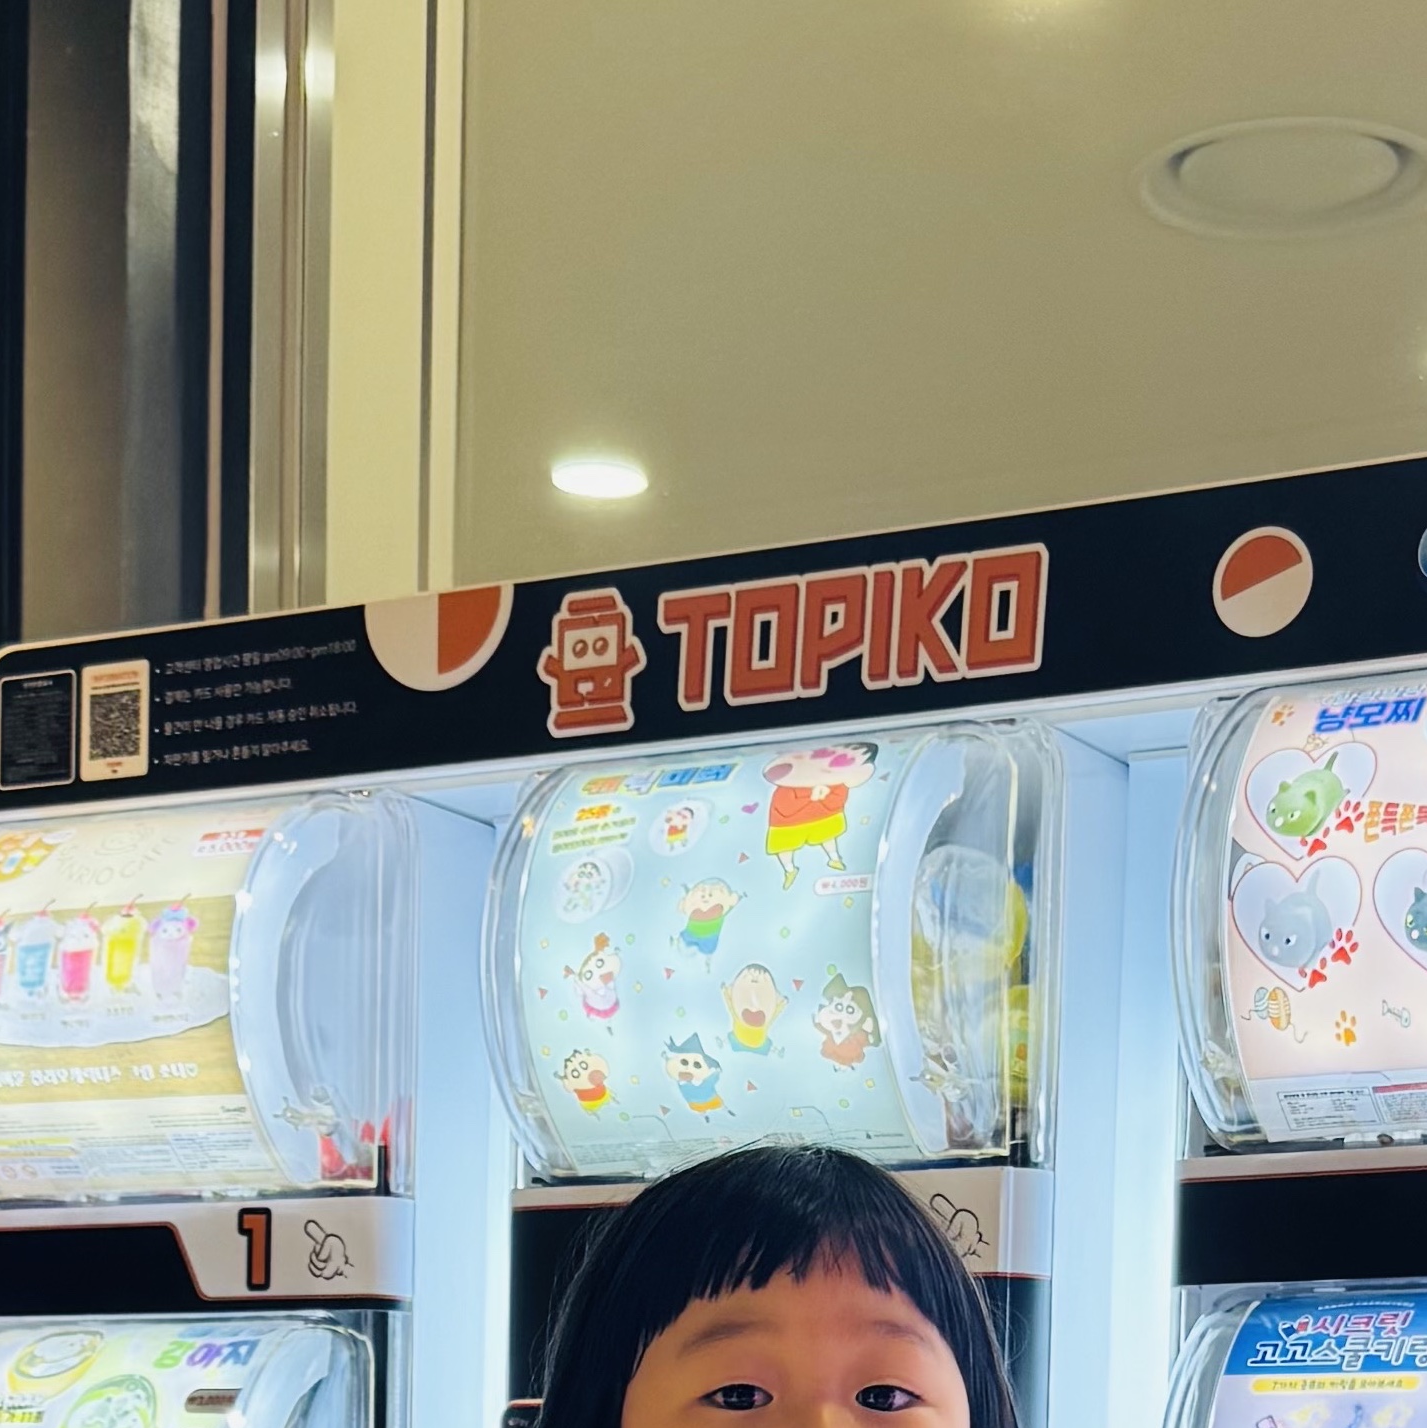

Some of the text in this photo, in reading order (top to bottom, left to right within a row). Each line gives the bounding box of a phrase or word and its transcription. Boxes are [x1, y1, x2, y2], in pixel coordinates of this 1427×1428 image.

[657, 543, 1049, 712] TOPIKO
[1314, 696, 1427, 734] 냥모찌
[238, 1207, 272, 1291] 1
[1312, 1310, 1415, 1338] 시크릿
